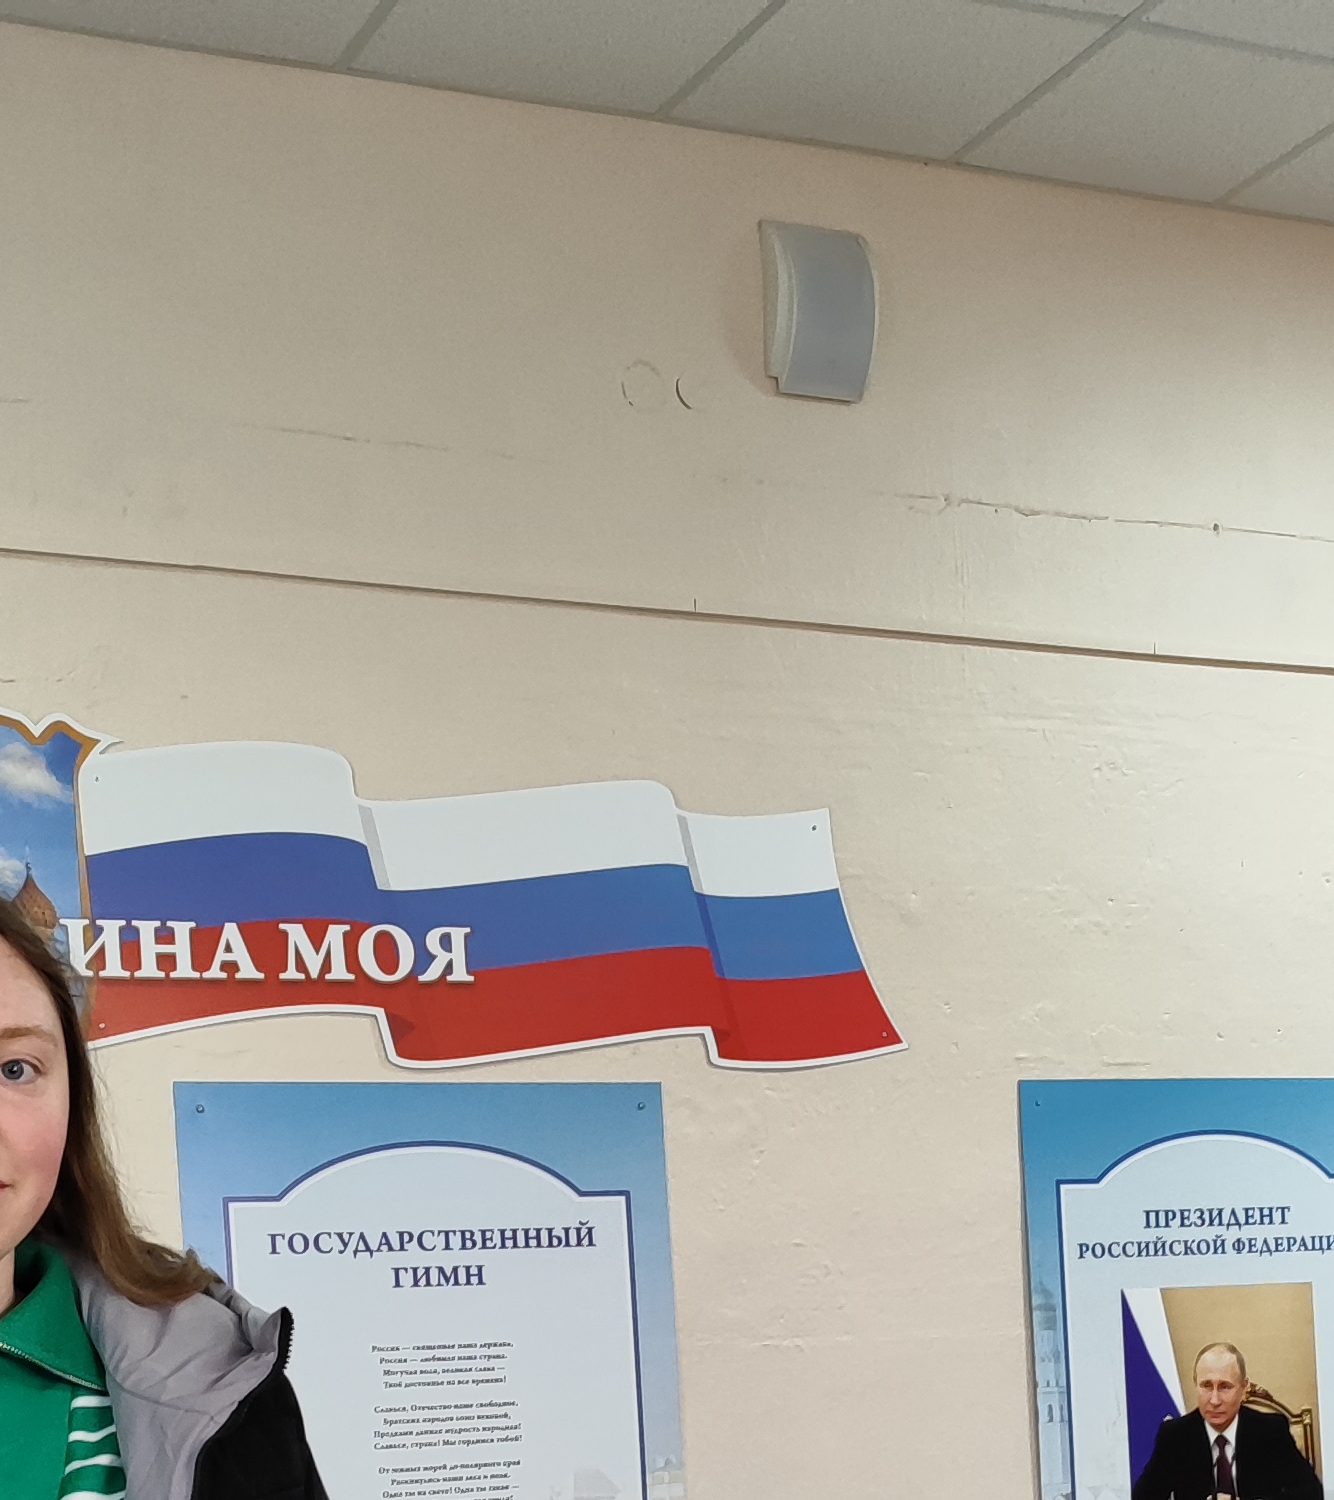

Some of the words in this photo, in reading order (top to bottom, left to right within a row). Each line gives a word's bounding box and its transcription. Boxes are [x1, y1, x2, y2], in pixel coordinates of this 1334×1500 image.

[59, 917, 265, 981] ИНА
[278, 922, 475, 983] МОЯ
[1143, 1206, 1291, 1231] ПРЕЗИДЕНТ
[267, 1220, 597, 1259] ГОСУДАРСТВЕННЫЙ
[1077, 1234, 1227, 1259] РОССИЙСКОЙ
[390, 1264, 486, 1288] ГИМН
